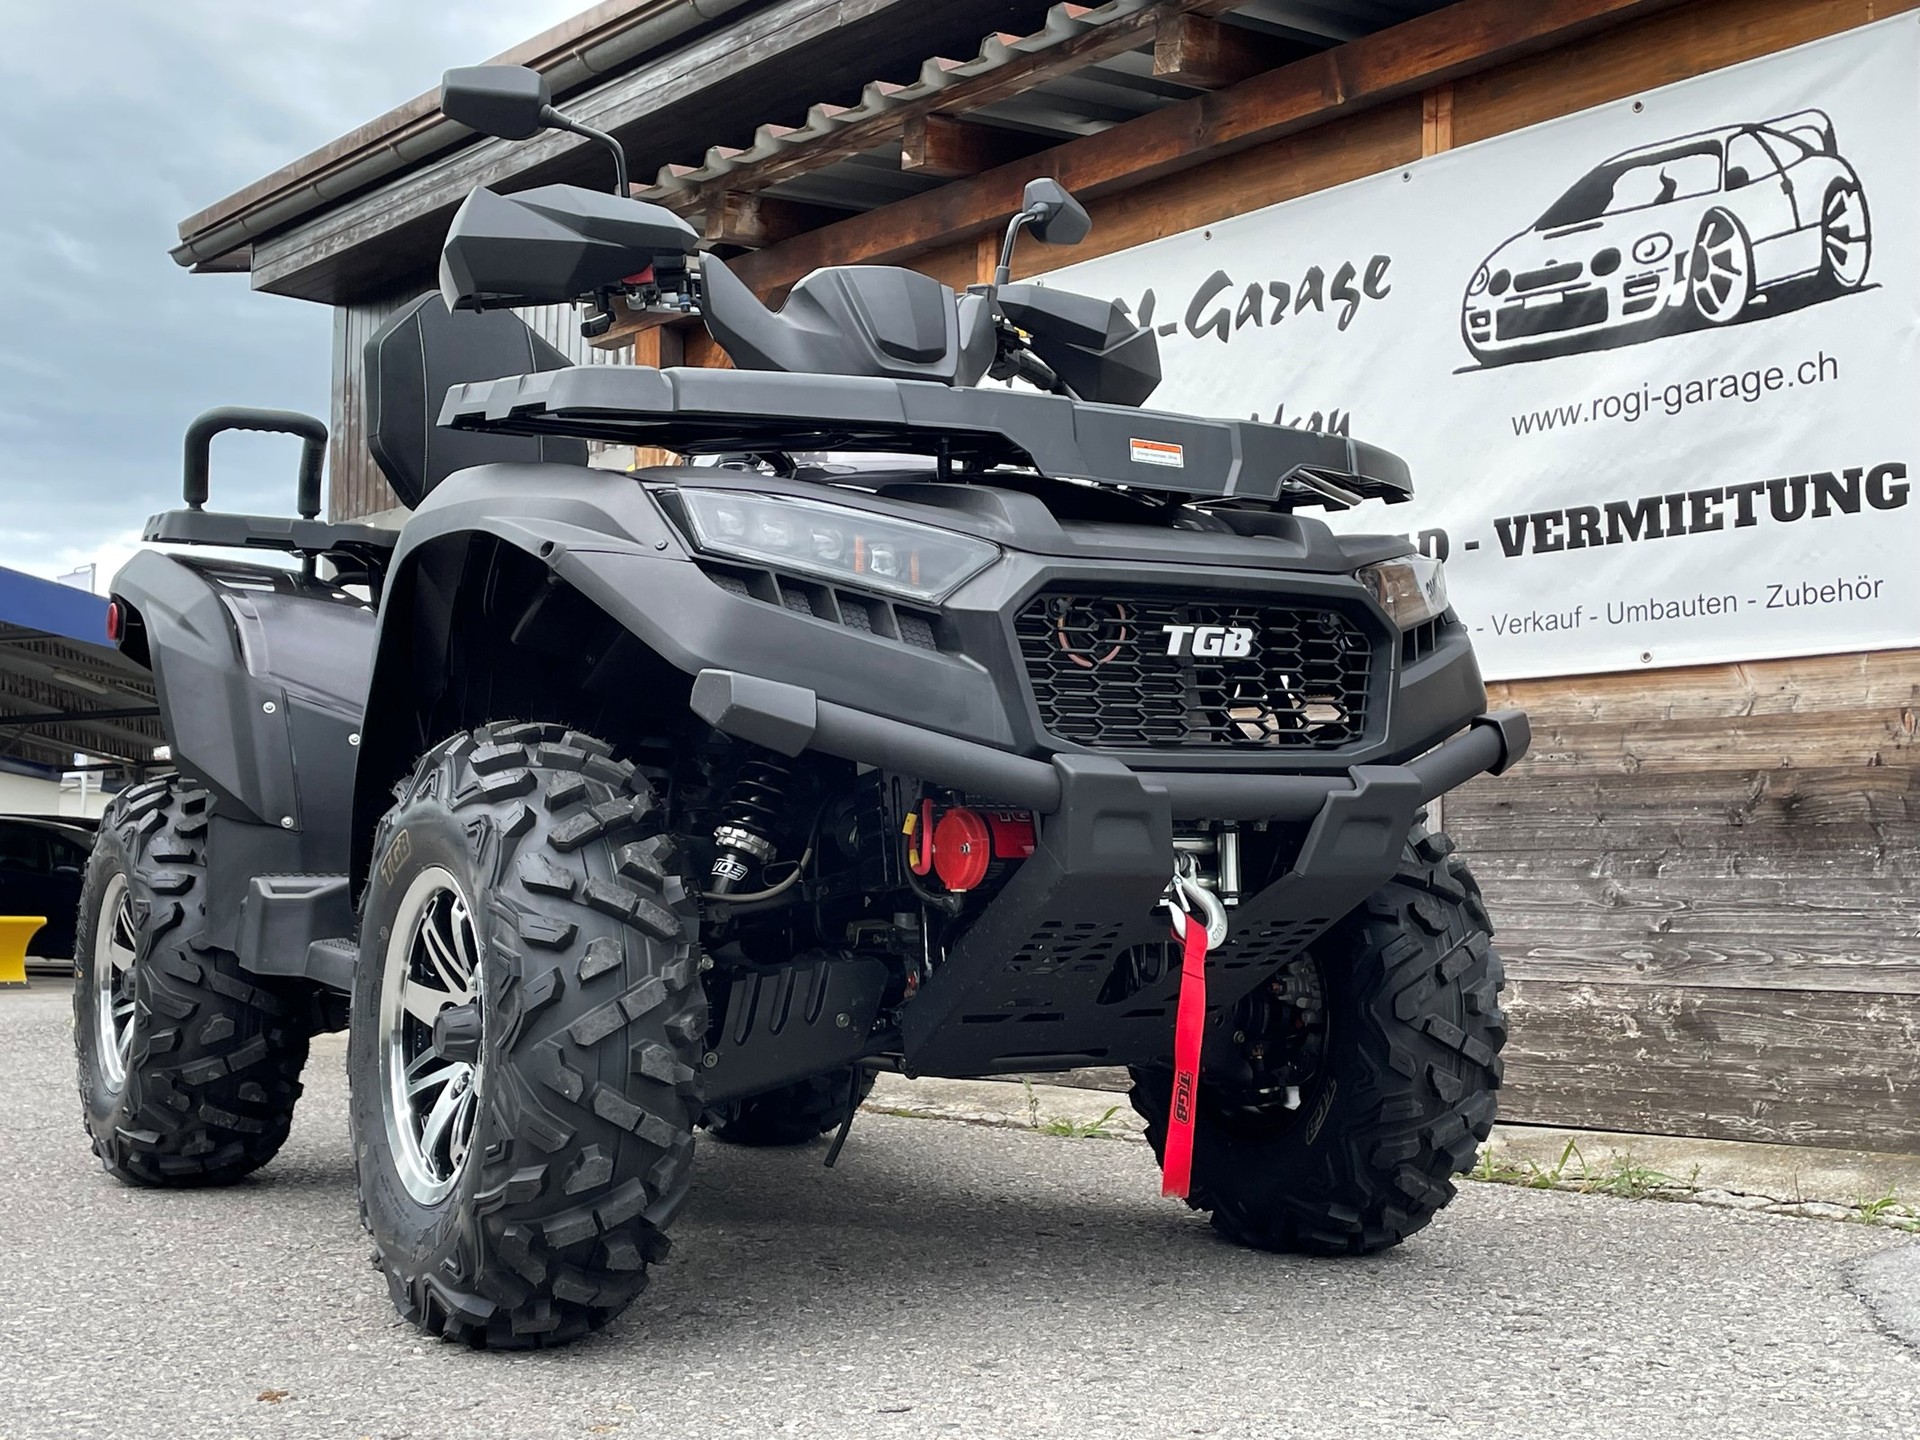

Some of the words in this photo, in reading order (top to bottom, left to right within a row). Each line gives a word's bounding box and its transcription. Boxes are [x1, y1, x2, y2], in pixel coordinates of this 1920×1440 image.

[1512, 351, 1838, 436] www.rogi-garage.ch
[1493, 462, 1911, 559] VERMIETUNG
[1491, 605, 1583, 636] Verkauf
[1607, 594, 1738, 625] Umbauten
[1765, 575, 1884, 609] Zubehör
[1162, 624, 1253, 657] TGB
[380, 828, 412, 887] TGB
[1173, 1070, 1193, 1125] TGB
